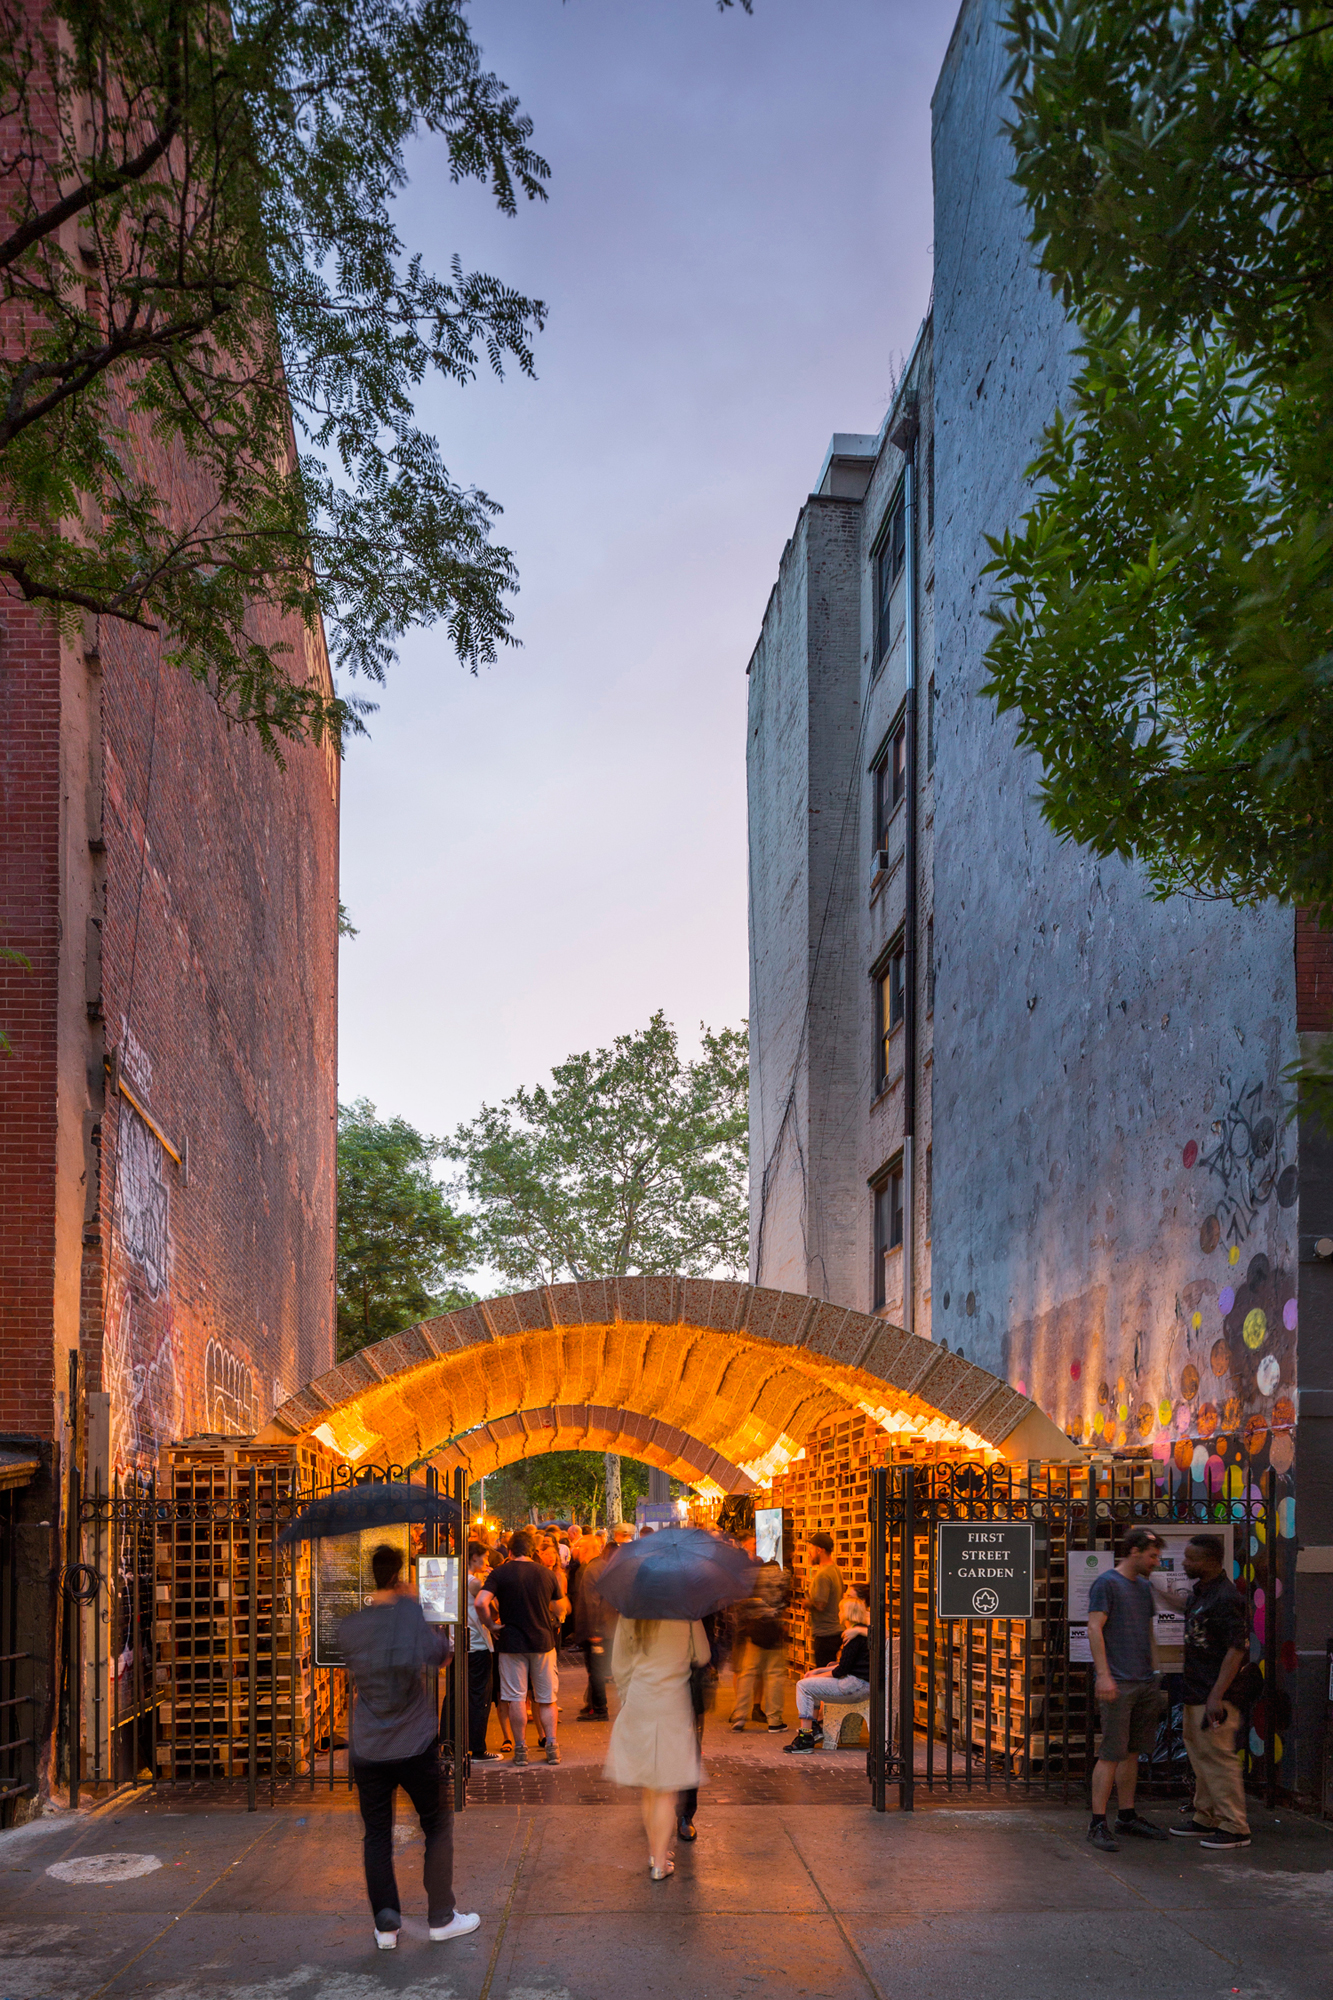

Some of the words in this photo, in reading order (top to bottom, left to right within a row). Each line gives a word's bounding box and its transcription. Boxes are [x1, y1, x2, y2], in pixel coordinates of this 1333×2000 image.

[967, 1532, 1005, 1543] FIRST
[961, 1550, 1011, 1560] STREET
[957, 1567, 1014, 1578] GARDEN
